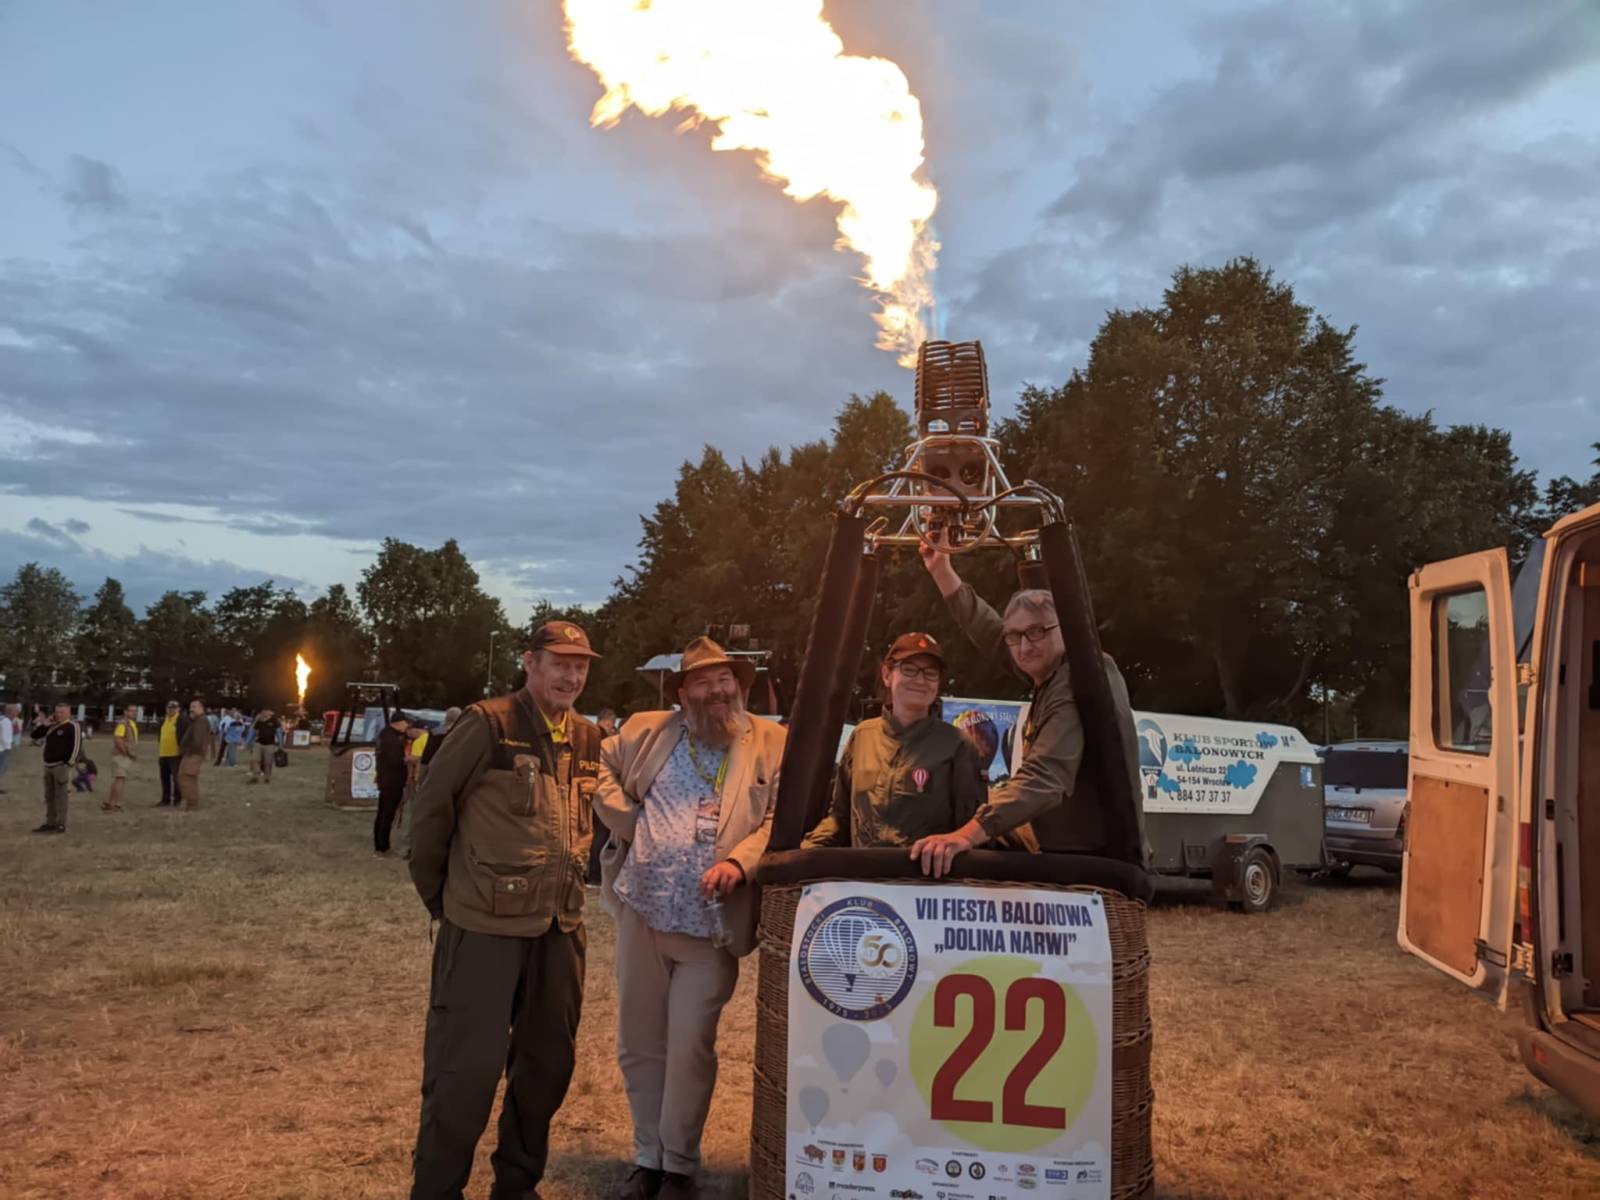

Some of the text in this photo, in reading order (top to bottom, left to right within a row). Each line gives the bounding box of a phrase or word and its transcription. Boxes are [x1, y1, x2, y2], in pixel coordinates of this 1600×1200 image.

[1174, 733, 1212, 745] KLUB
[1175, 744, 1265, 760] BALONOWYCH
[1177, 775, 1201, 785] 54-154
[1177, 789, 1232, 804] 884 37 37 37
[915, 897, 1093, 928] VII FIESTA BALONOWA
[895, 918, 917, 980] BALONOWY
[930, 972, 1067, 1130] 22
